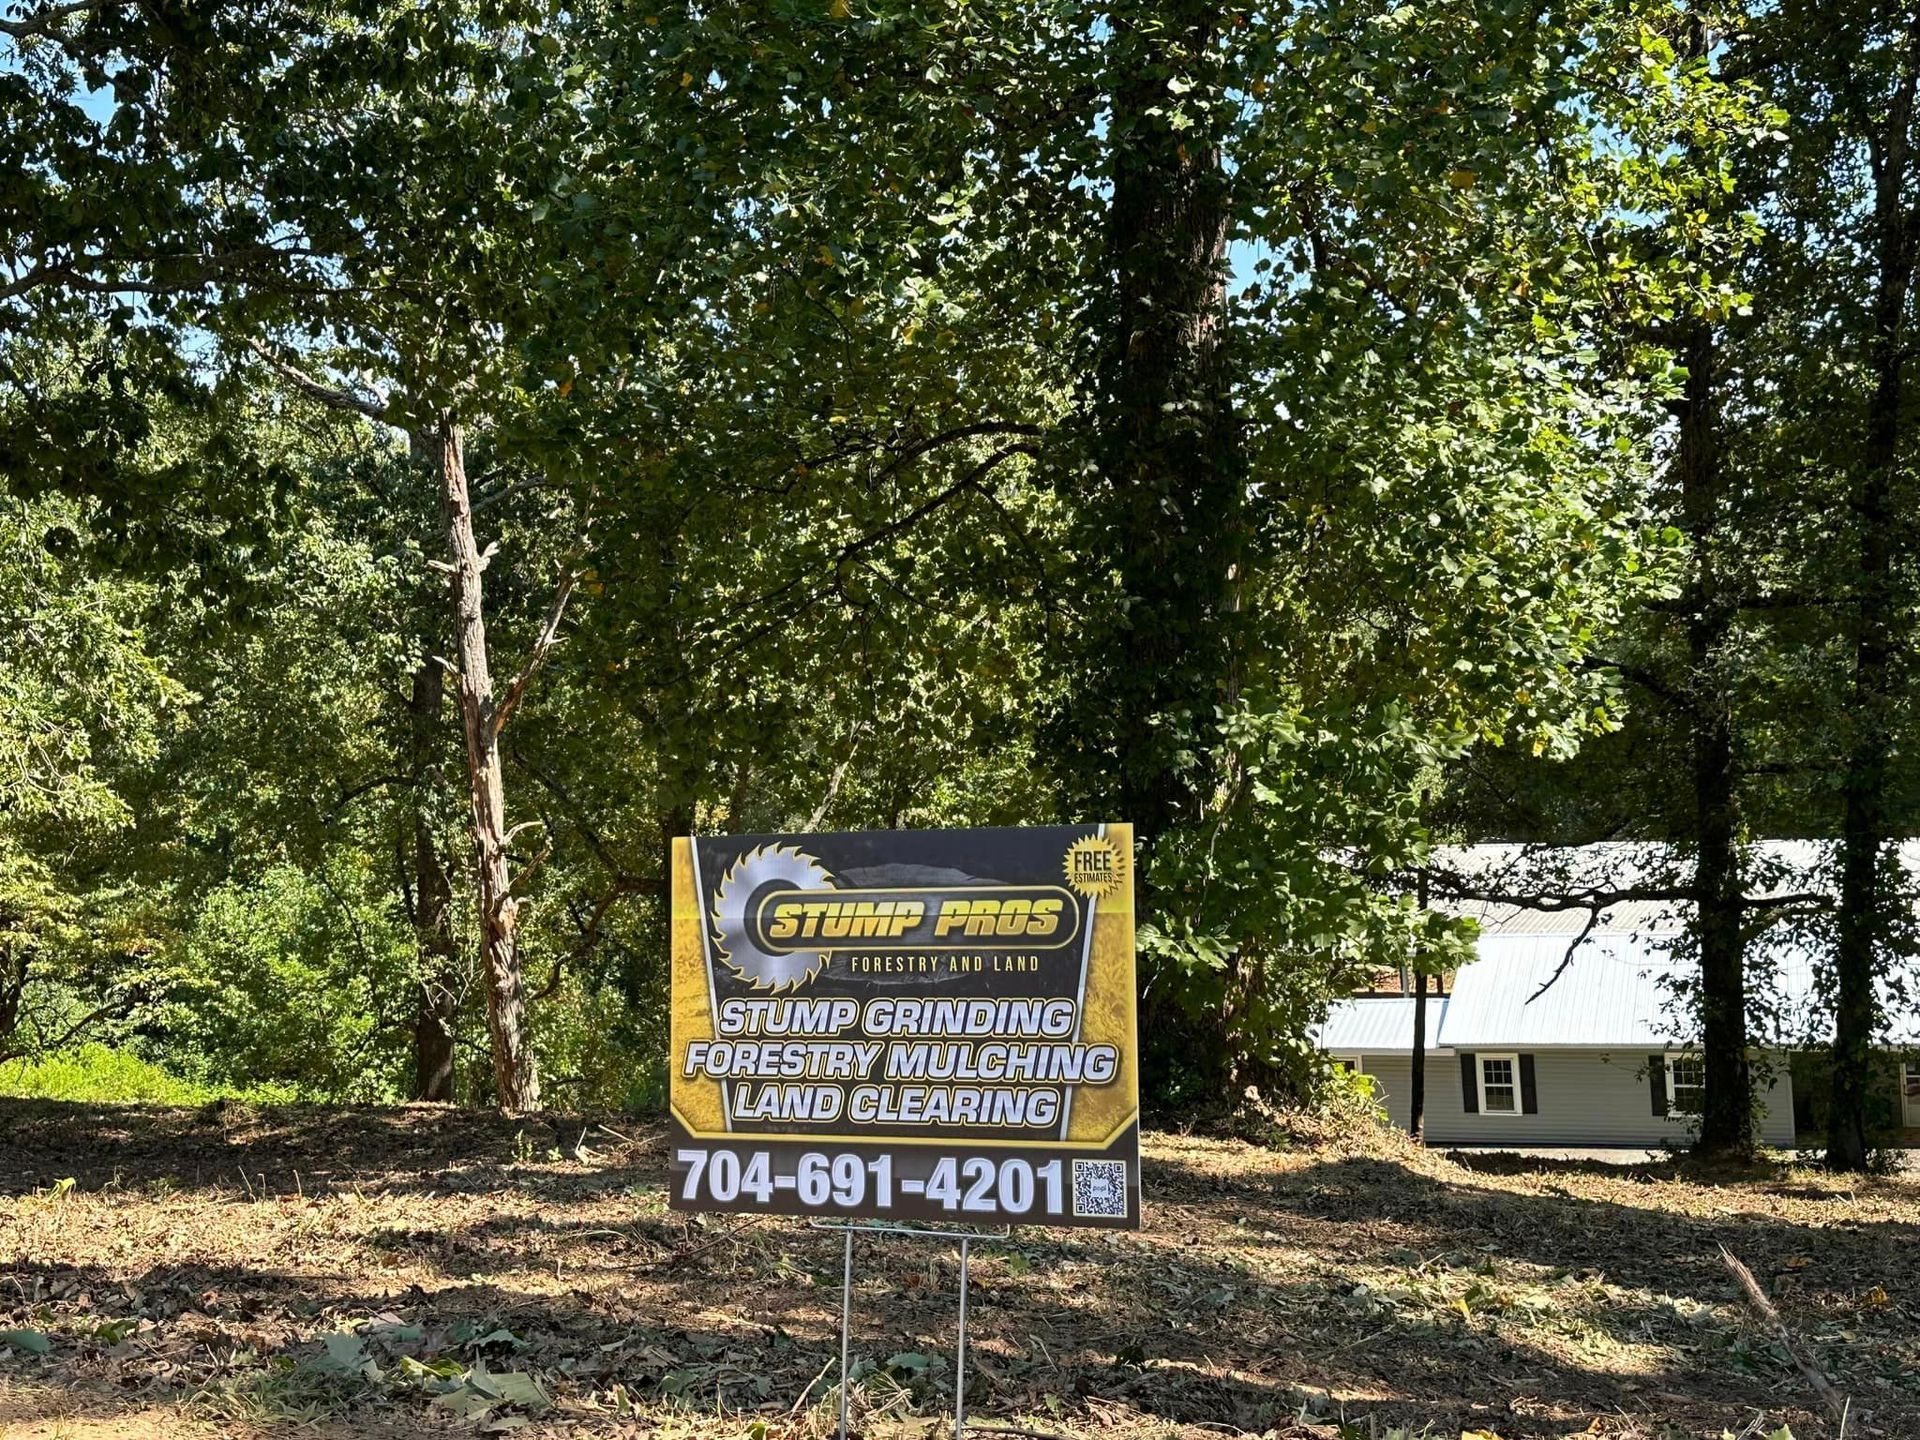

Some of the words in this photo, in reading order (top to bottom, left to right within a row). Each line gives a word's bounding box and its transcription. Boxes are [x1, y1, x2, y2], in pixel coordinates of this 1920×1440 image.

[1074, 850, 1112, 871] FREE
[1074, 872, 1113, 883] ESTIMATES
[769, 901, 926, 938] STUMP
[934, 898, 1063, 936] PROS
[850, 956, 938, 973] FORESTRY
[949, 955, 983, 972] AND
[994, 955, 1040, 971] LAND
[719, 999, 857, 1036] STUMP
[863, 1000, 1075, 1037] GRINDING
[683, 1042, 882, 1079] FORESTRY
[887, 1043, 1118, 1083] MULCHING
[732, 1085, 844, 1122] LAND
[848, 1088, 1060, 1126] CLEARING
[677, 1149, 1063, 1214] 704-691-4201
